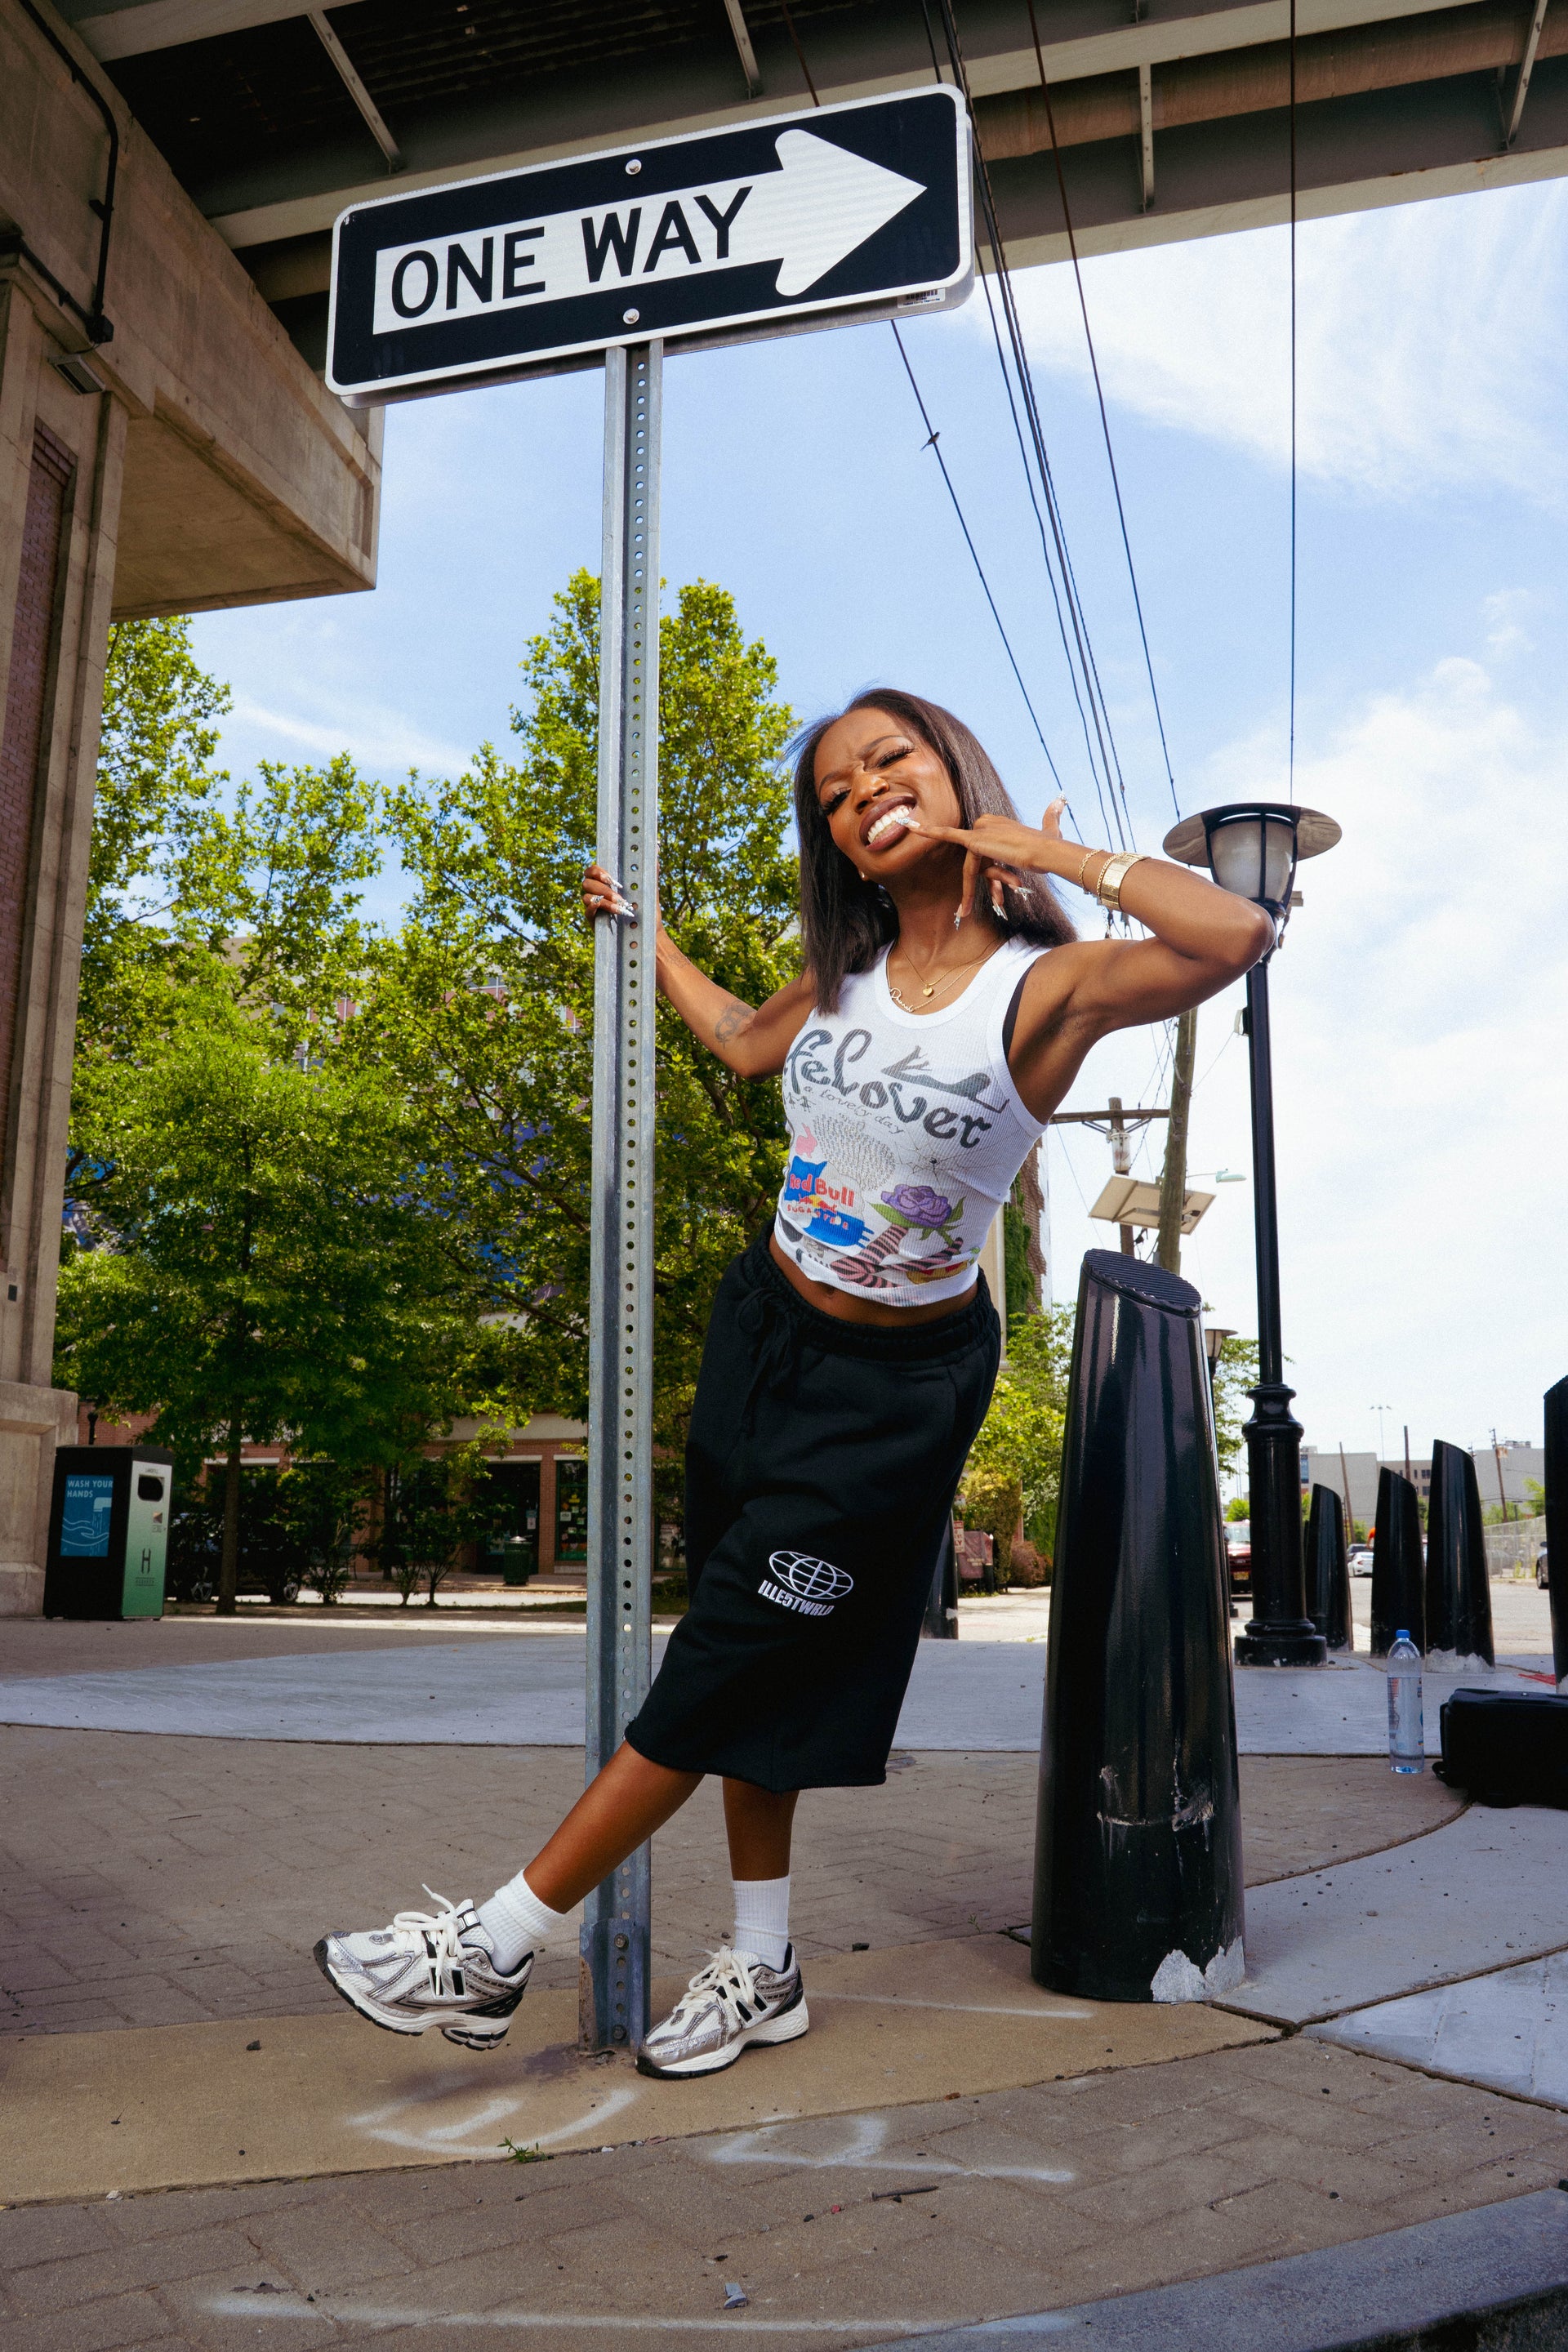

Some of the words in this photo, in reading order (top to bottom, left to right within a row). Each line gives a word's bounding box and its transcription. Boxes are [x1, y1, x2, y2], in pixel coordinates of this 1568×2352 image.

[390, 226, 546, 318] ONE
[581, 185, 753, 283] WAY
[874, 1116, 905, 1134] day
[790, 1174, 813, 1192] Red
[815, 1178, 855, 1207] Bull
[68, 1479, 90, 1489] WASH
[92, 1479, 114, 1489] YOUR
[66, 1490, 94, 1499] HANDS
